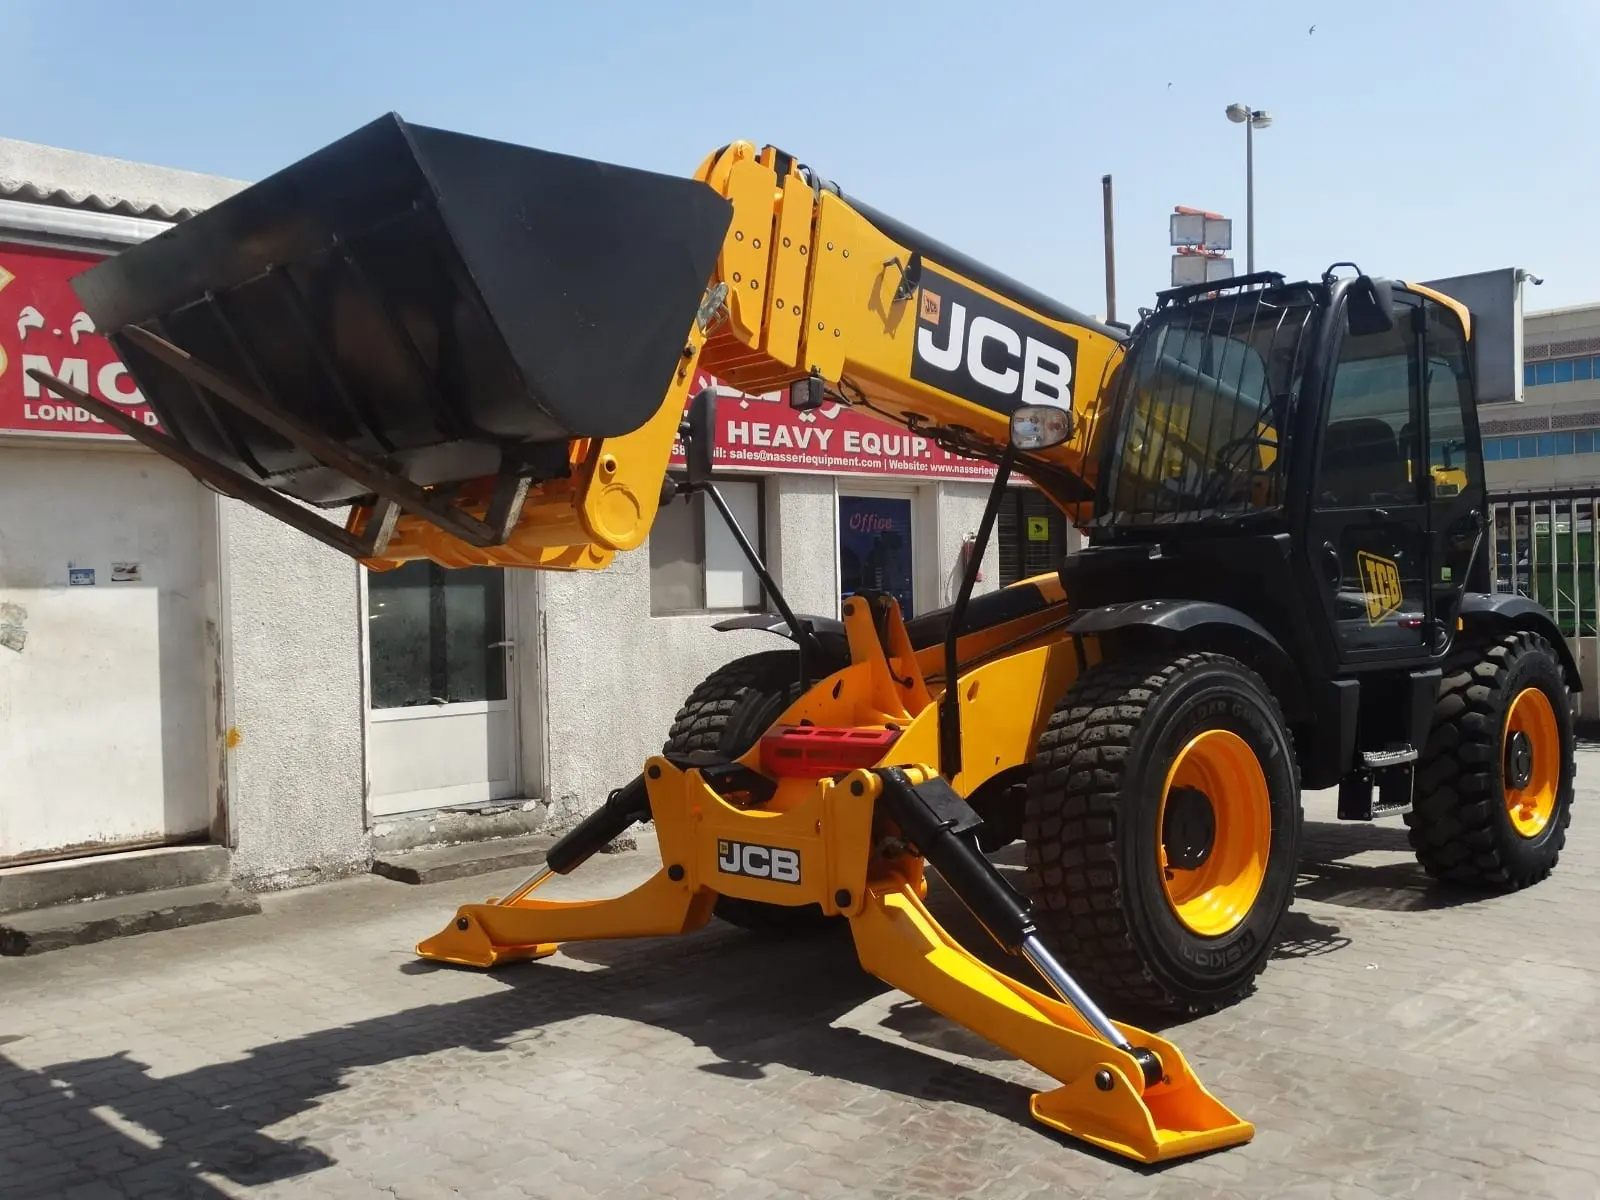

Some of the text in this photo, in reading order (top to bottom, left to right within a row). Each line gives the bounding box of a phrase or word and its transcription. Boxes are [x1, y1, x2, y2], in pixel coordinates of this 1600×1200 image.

[918, 302, 1072, 411] JCB
[24, 404, 106, 423] LOND
[727, 420, 931, 459] HEAVY EQUIP.
[729, 449, 882, 470] sales@nasseriequipment.com
[889, 459, 928, 471] Website:
[1366, 559, 1400, 617] JCB
[720, 843, 800, 881] JCB
